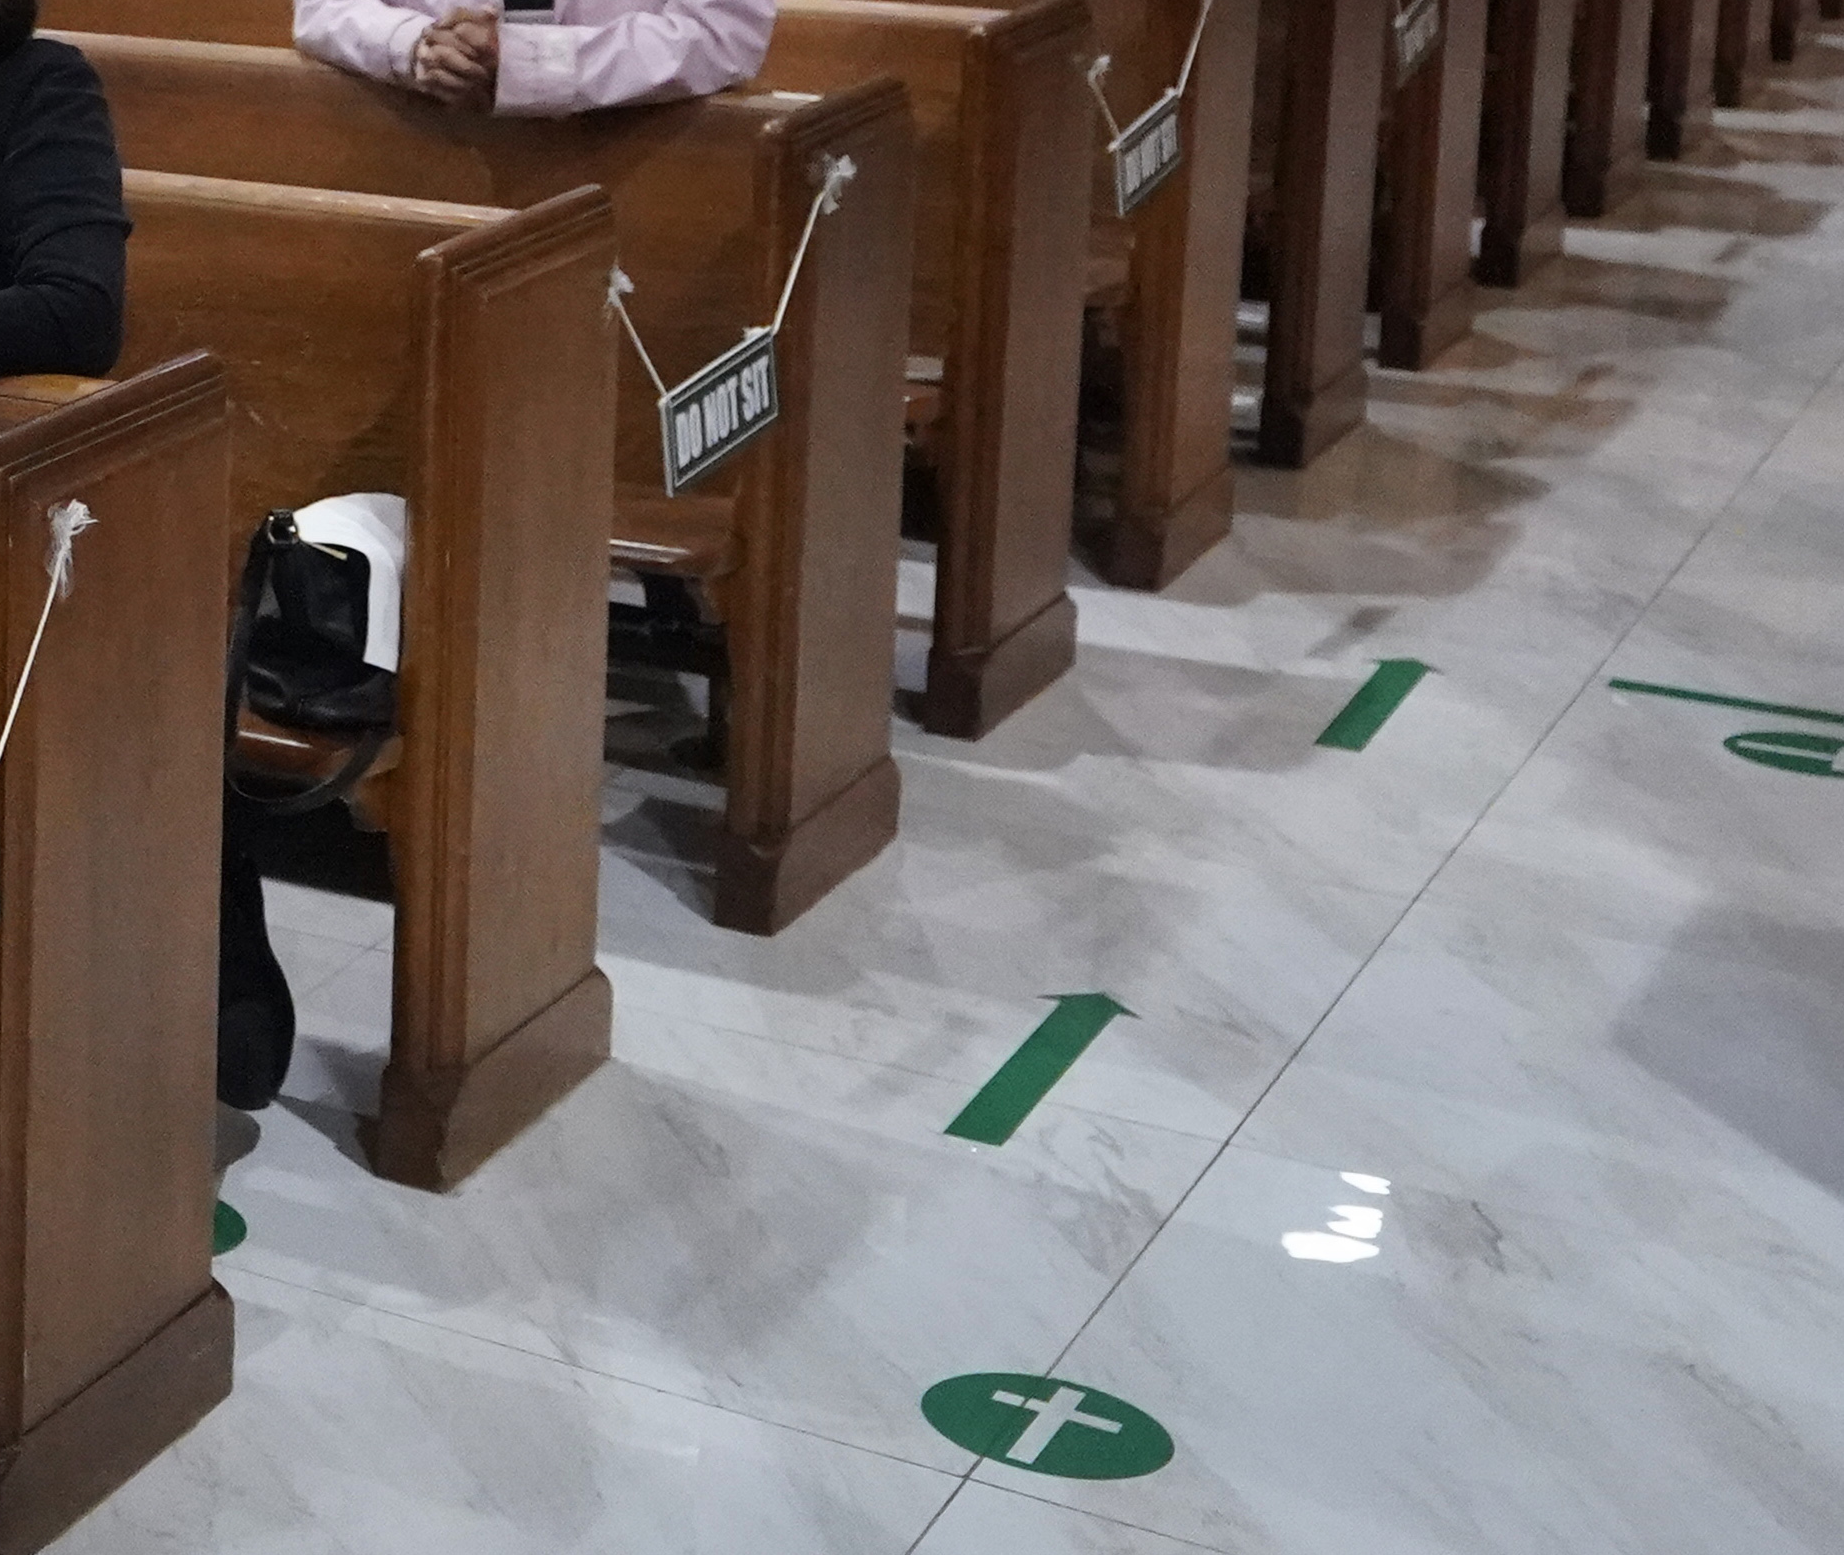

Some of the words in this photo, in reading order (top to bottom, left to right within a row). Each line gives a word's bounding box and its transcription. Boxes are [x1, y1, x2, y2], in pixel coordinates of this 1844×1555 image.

[675, 403, 703, 469] DO
[703, 374, 740, 448] NOT
[741, 355, 770, 422] SIT
